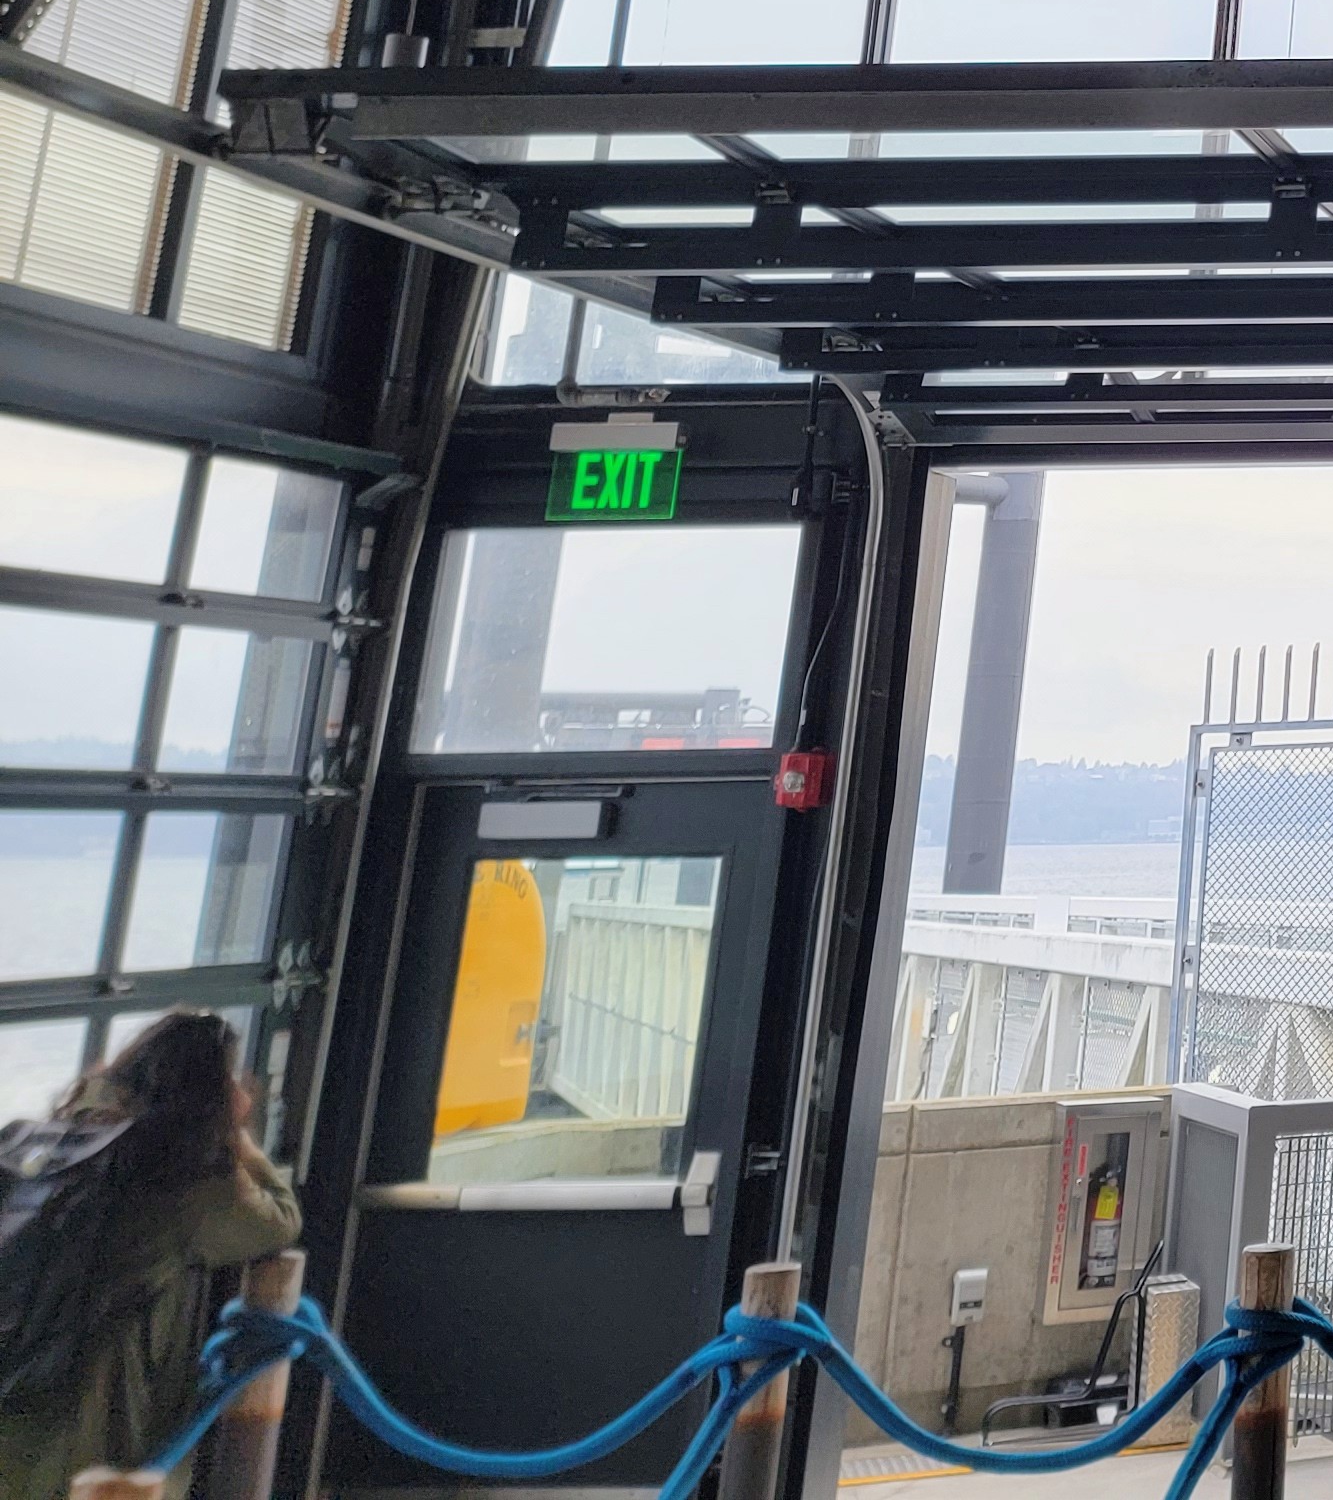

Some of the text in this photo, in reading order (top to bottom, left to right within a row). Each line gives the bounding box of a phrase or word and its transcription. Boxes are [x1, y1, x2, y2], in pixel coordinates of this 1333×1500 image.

[571, 451, 663, 509] EXIT
[1063, 1116, 1075, 1158] FIRE
[1050, 1161, 1072, 1285] EXTINGUISHER
